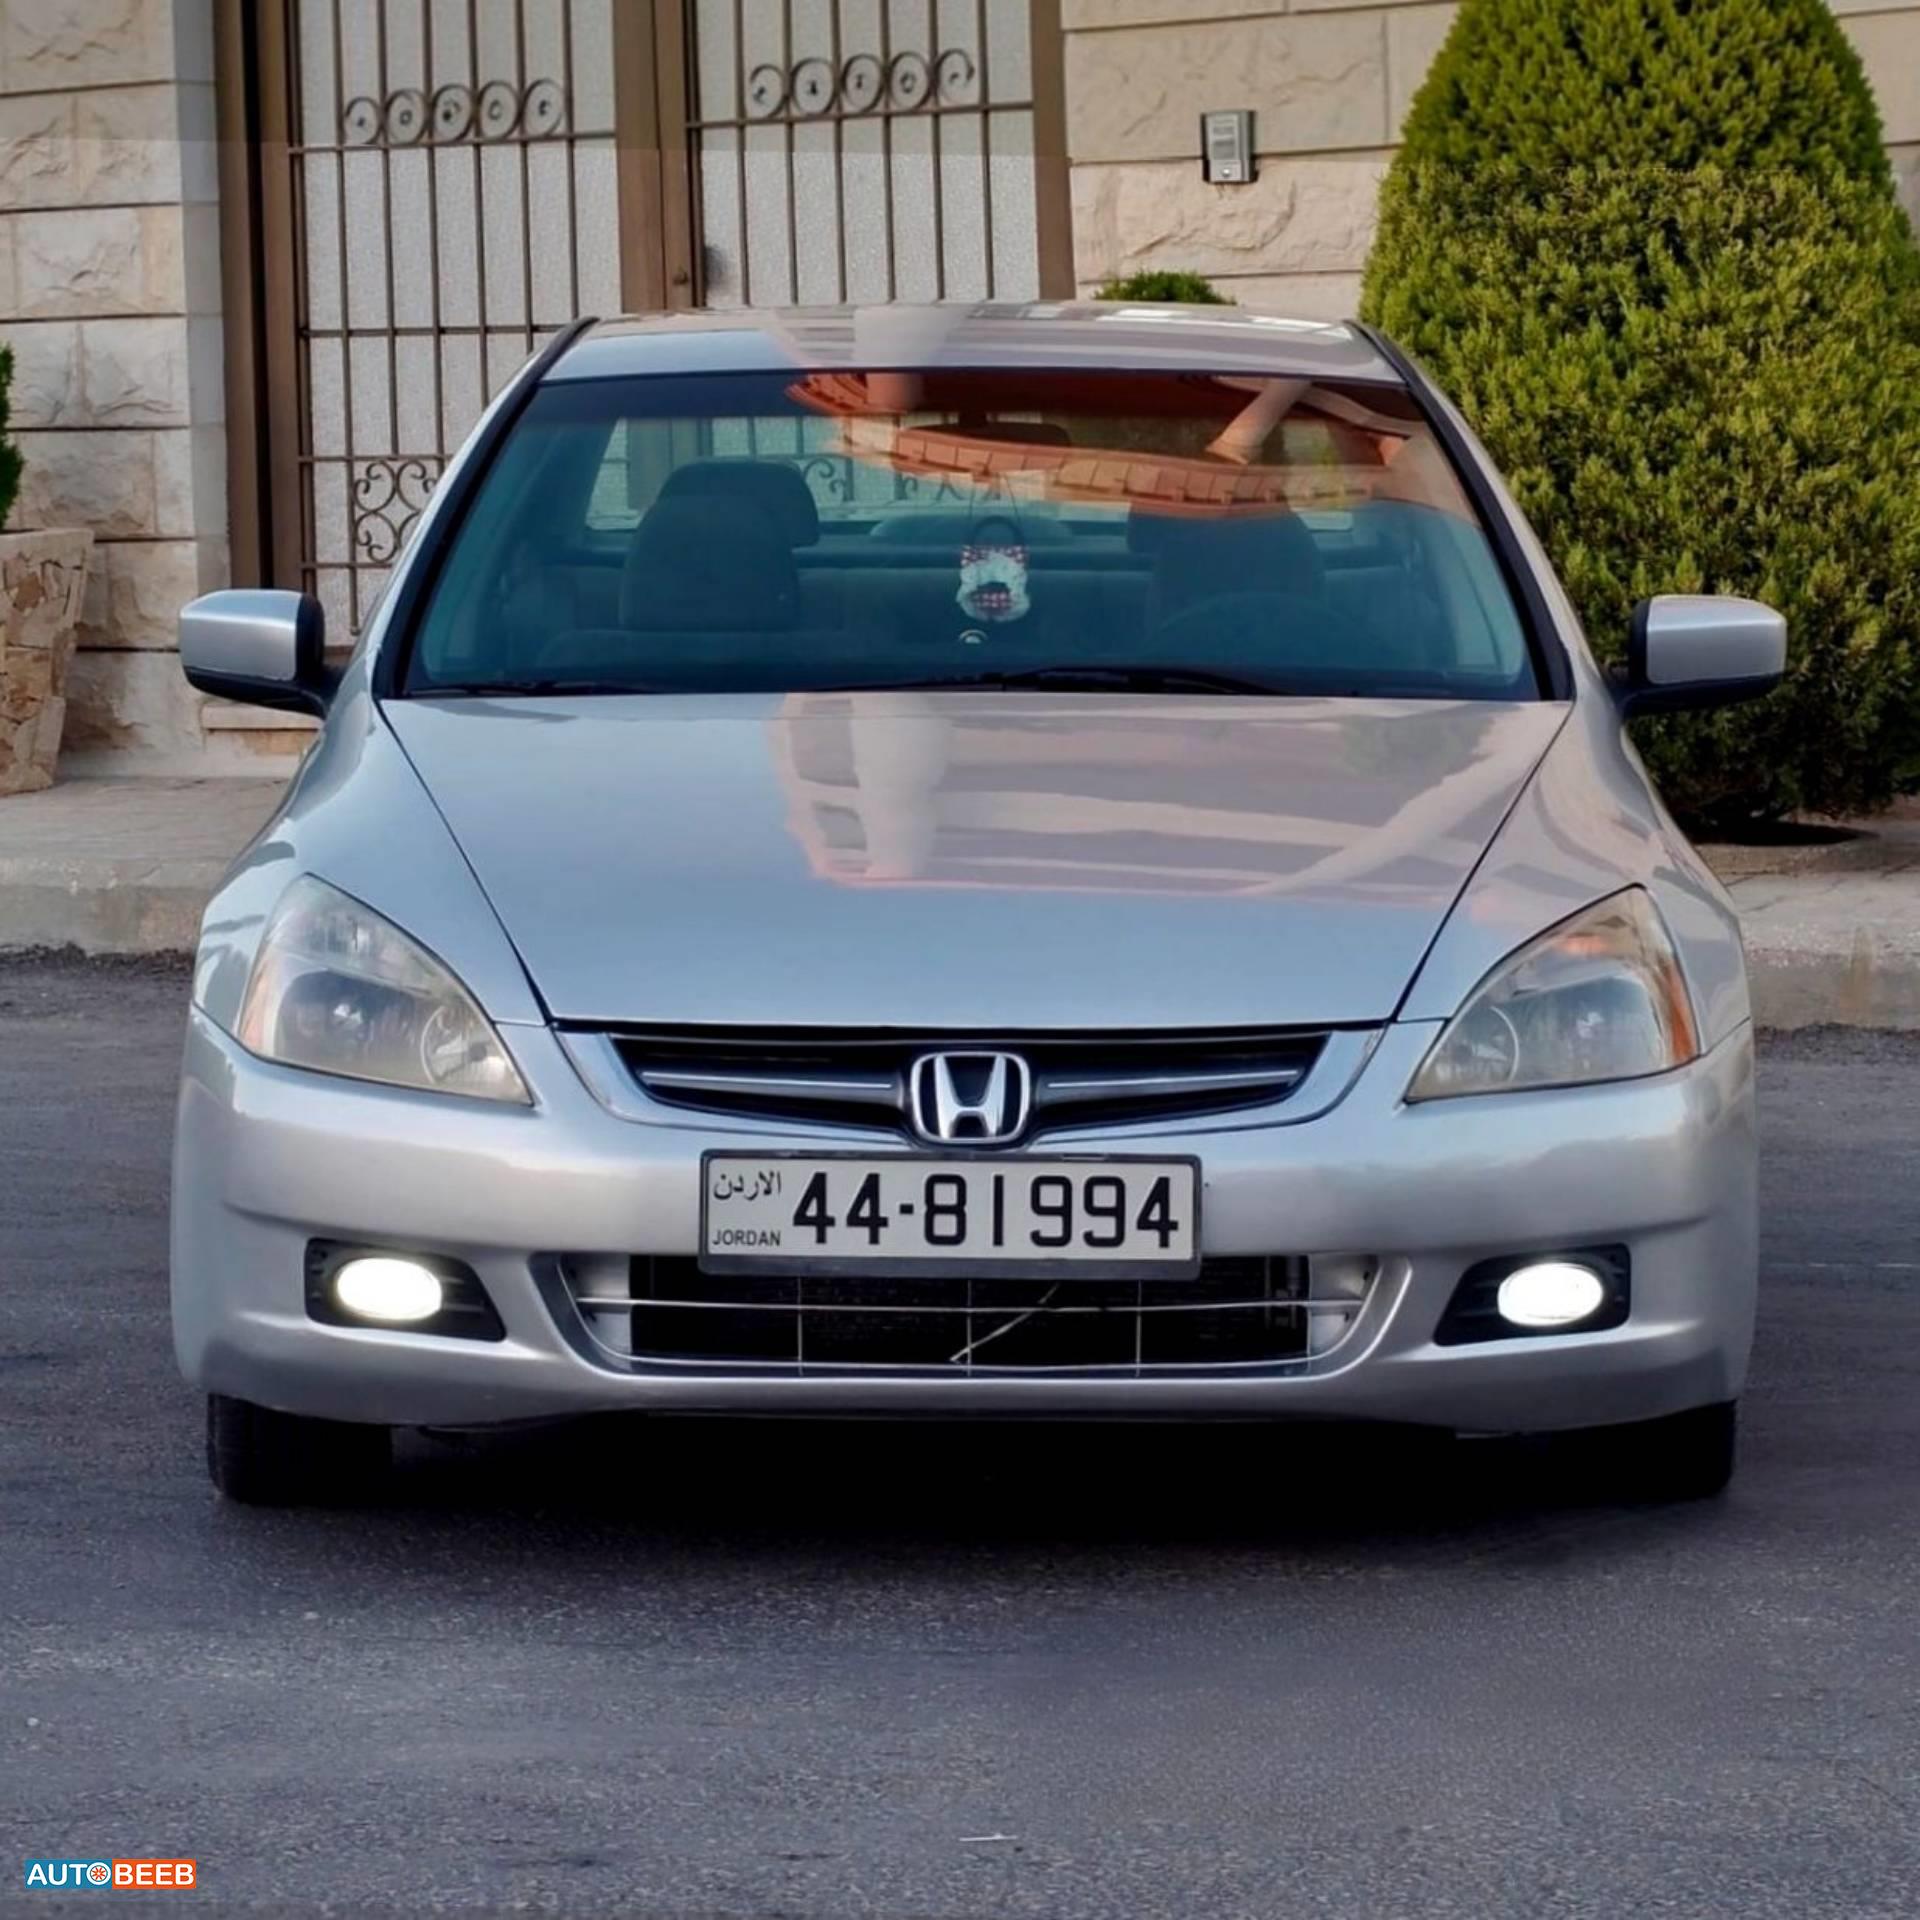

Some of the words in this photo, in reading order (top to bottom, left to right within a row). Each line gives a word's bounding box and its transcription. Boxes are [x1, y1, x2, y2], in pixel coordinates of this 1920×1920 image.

[713, 1170, 782, 1200] الاردن
[792, 1171, 1180, 1249] 44-81994
[712, 1229, 781, 1247] JORDAN
